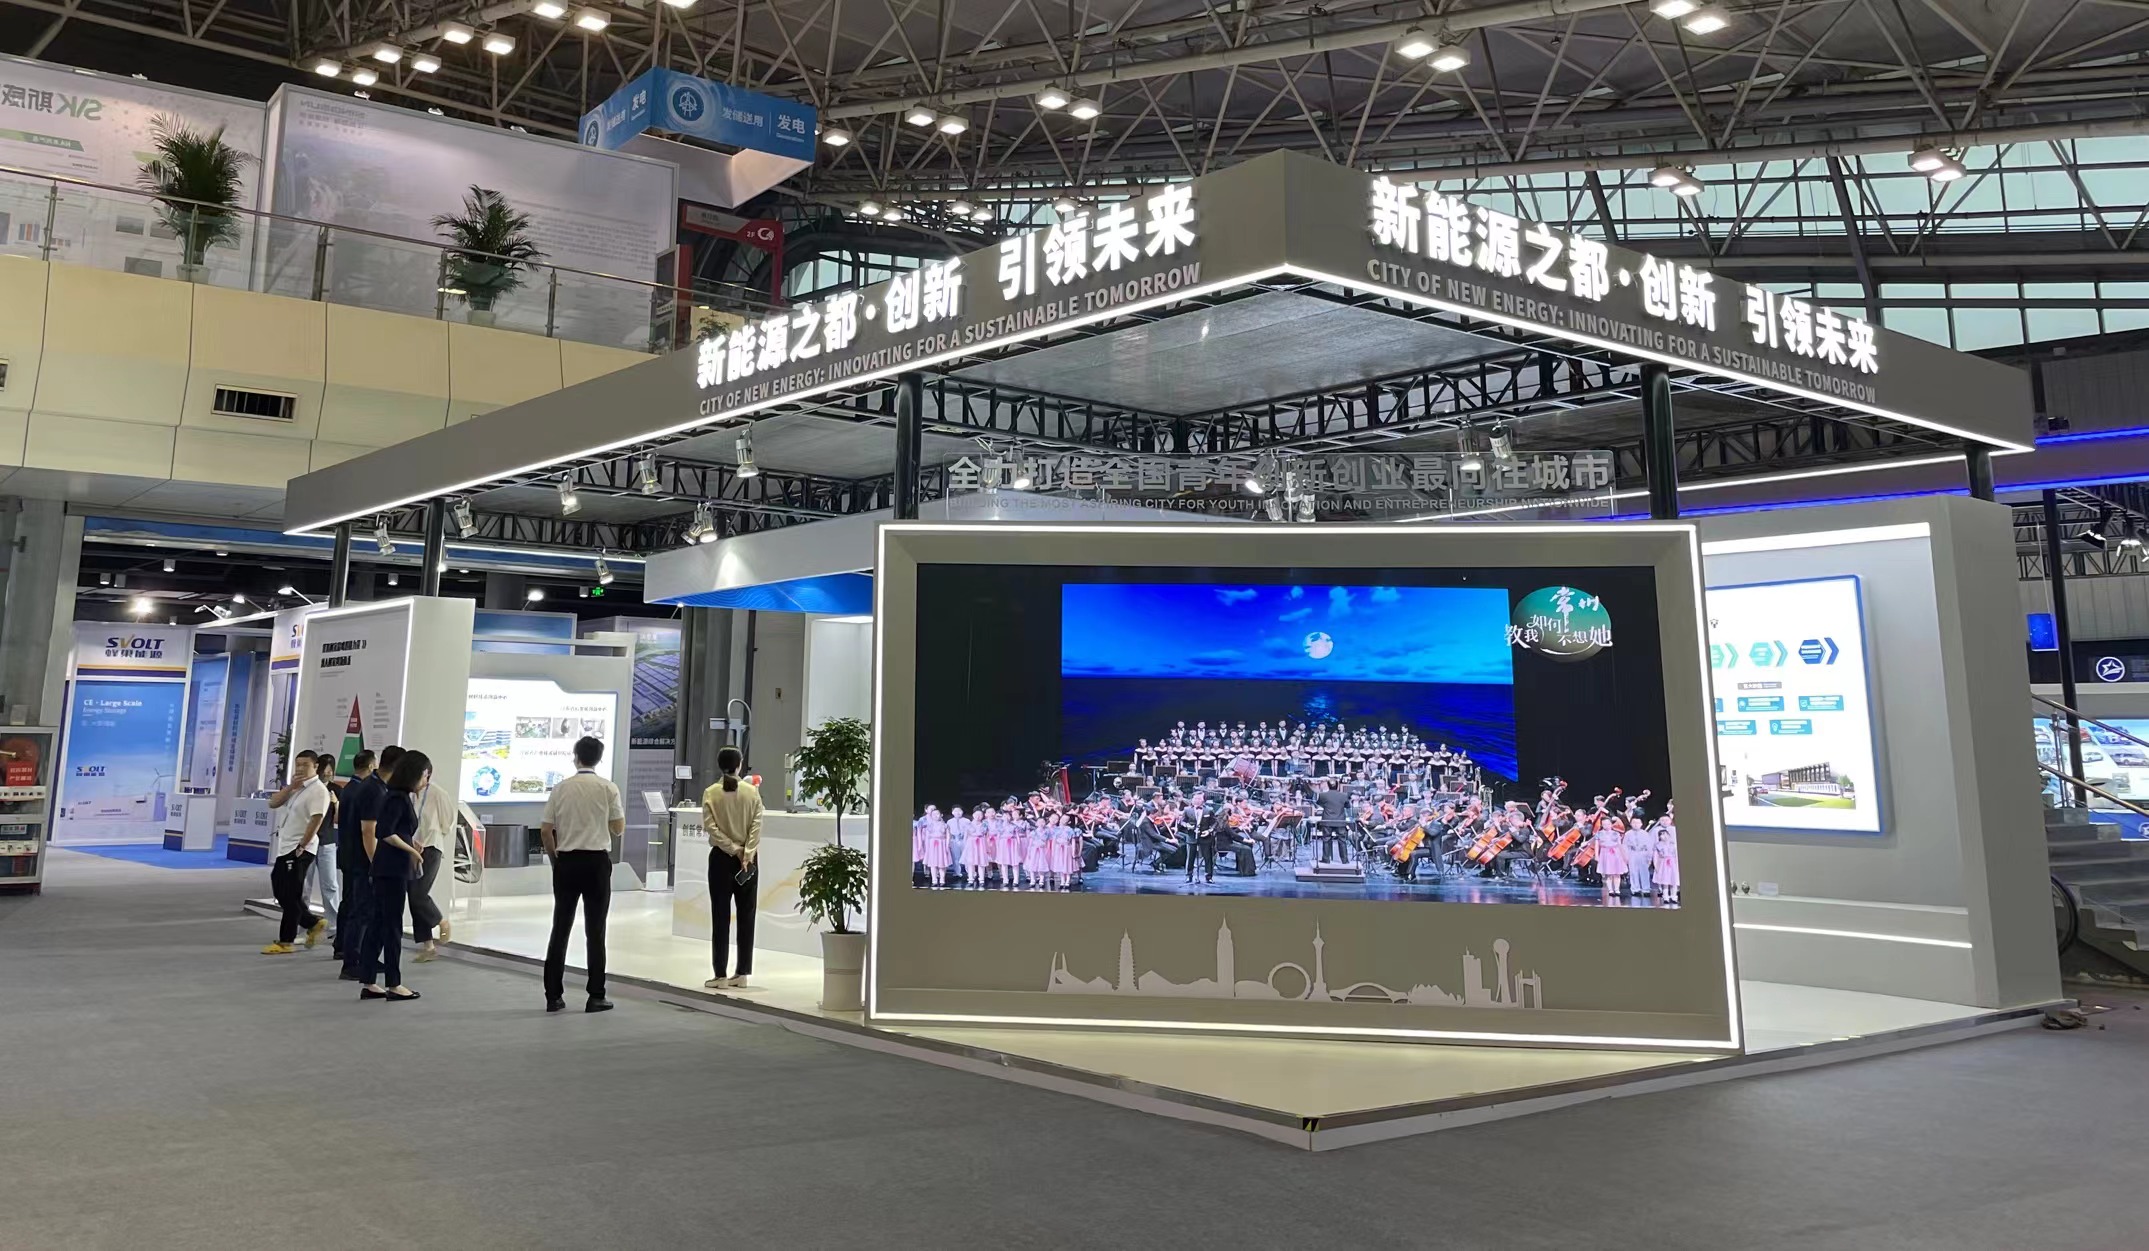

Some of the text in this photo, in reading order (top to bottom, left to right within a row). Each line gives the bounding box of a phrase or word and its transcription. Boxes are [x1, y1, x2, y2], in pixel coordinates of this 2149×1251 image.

[632, 90, 647, 110] 发电
[777, 115, 806, 134] 发电
[1371, 175, 1880, 378] 新能源之都·创新 引领未来
[697, 184, 1197, 390] 新能源之都·创新 引领未来
[699, 262, 1201, 417] CITY OF NEW ENERGY: INNOVATING FOR A SUSTAINABLE TOMORROW
[1367, 259, 1877, 405] CITY OF NEW ENERGY: INNOVATING FOR A SUSTAINABLE TOMORROW
[1014, 498, 1038, 510] THE
[1041, 498, 1077, 510] MOST
[1081, 498, 1142, 510] ASPIRING
[1145, 499, 1177, 510] CITY
[1180, 499, 1206, 510] FOR
[1210, 499, 1254, 510] YOUTH
[1344, 499, 1373, 511] AND
[1375, 498, 1518, 511] ENTREPRENEURSHIP
[1521, 498, 1609, 510] NATIONWIDE
[105, 633, 165, 649] SVOLT
[100, 699, 122, 709] Large
[123, 700, 143, 708] Scale
